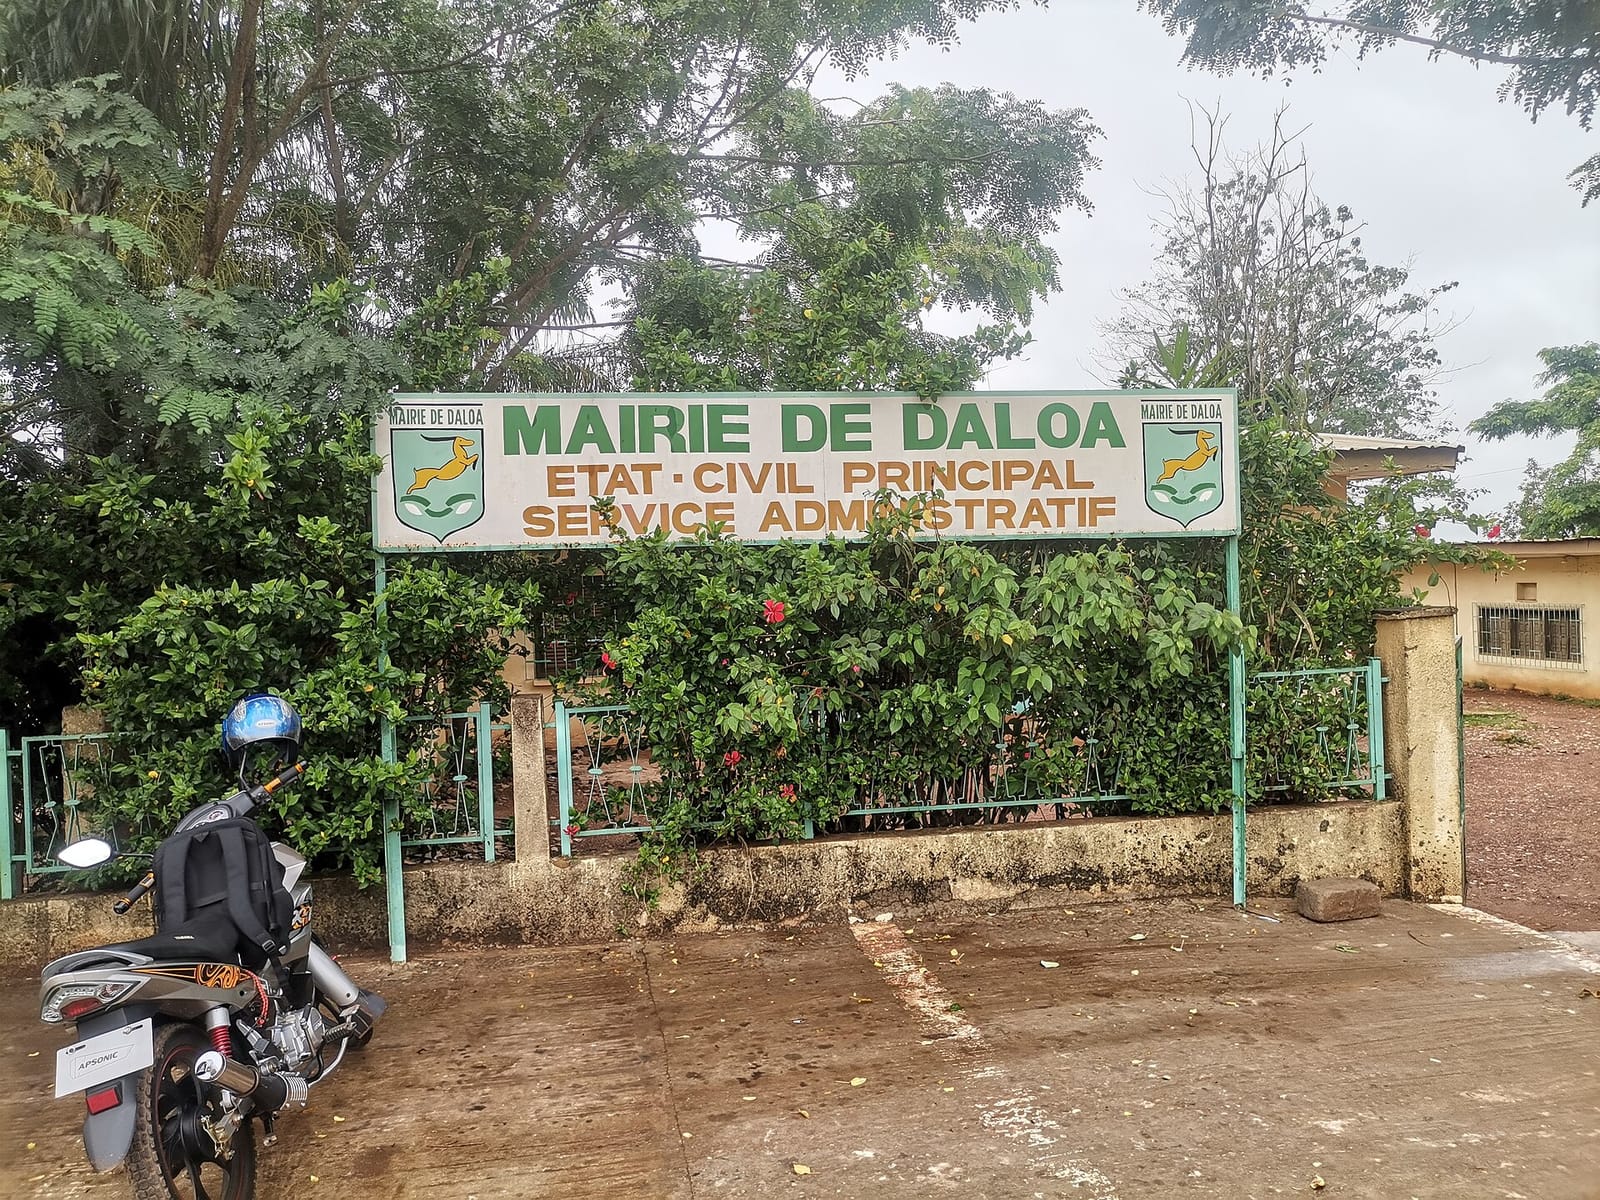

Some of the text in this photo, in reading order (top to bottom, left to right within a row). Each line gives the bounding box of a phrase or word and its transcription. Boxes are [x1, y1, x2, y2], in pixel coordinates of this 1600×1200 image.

[389, 407, 484, 425] MAIRIE DE DALOA
[1141, 403, 1222, 419] MAIRIE DE DALOA
[502, 402, 1126, 456] MAIRIE DE DALOA
[547, 463, 662, 497] ETAT
[693, 463, 814, 494] CIVIL
[843, 460, 1095, 493] PRINCIPAL
[523, 501, 736, 537] SERVICE
[78, 1051, 119, 1071] APSONIC
